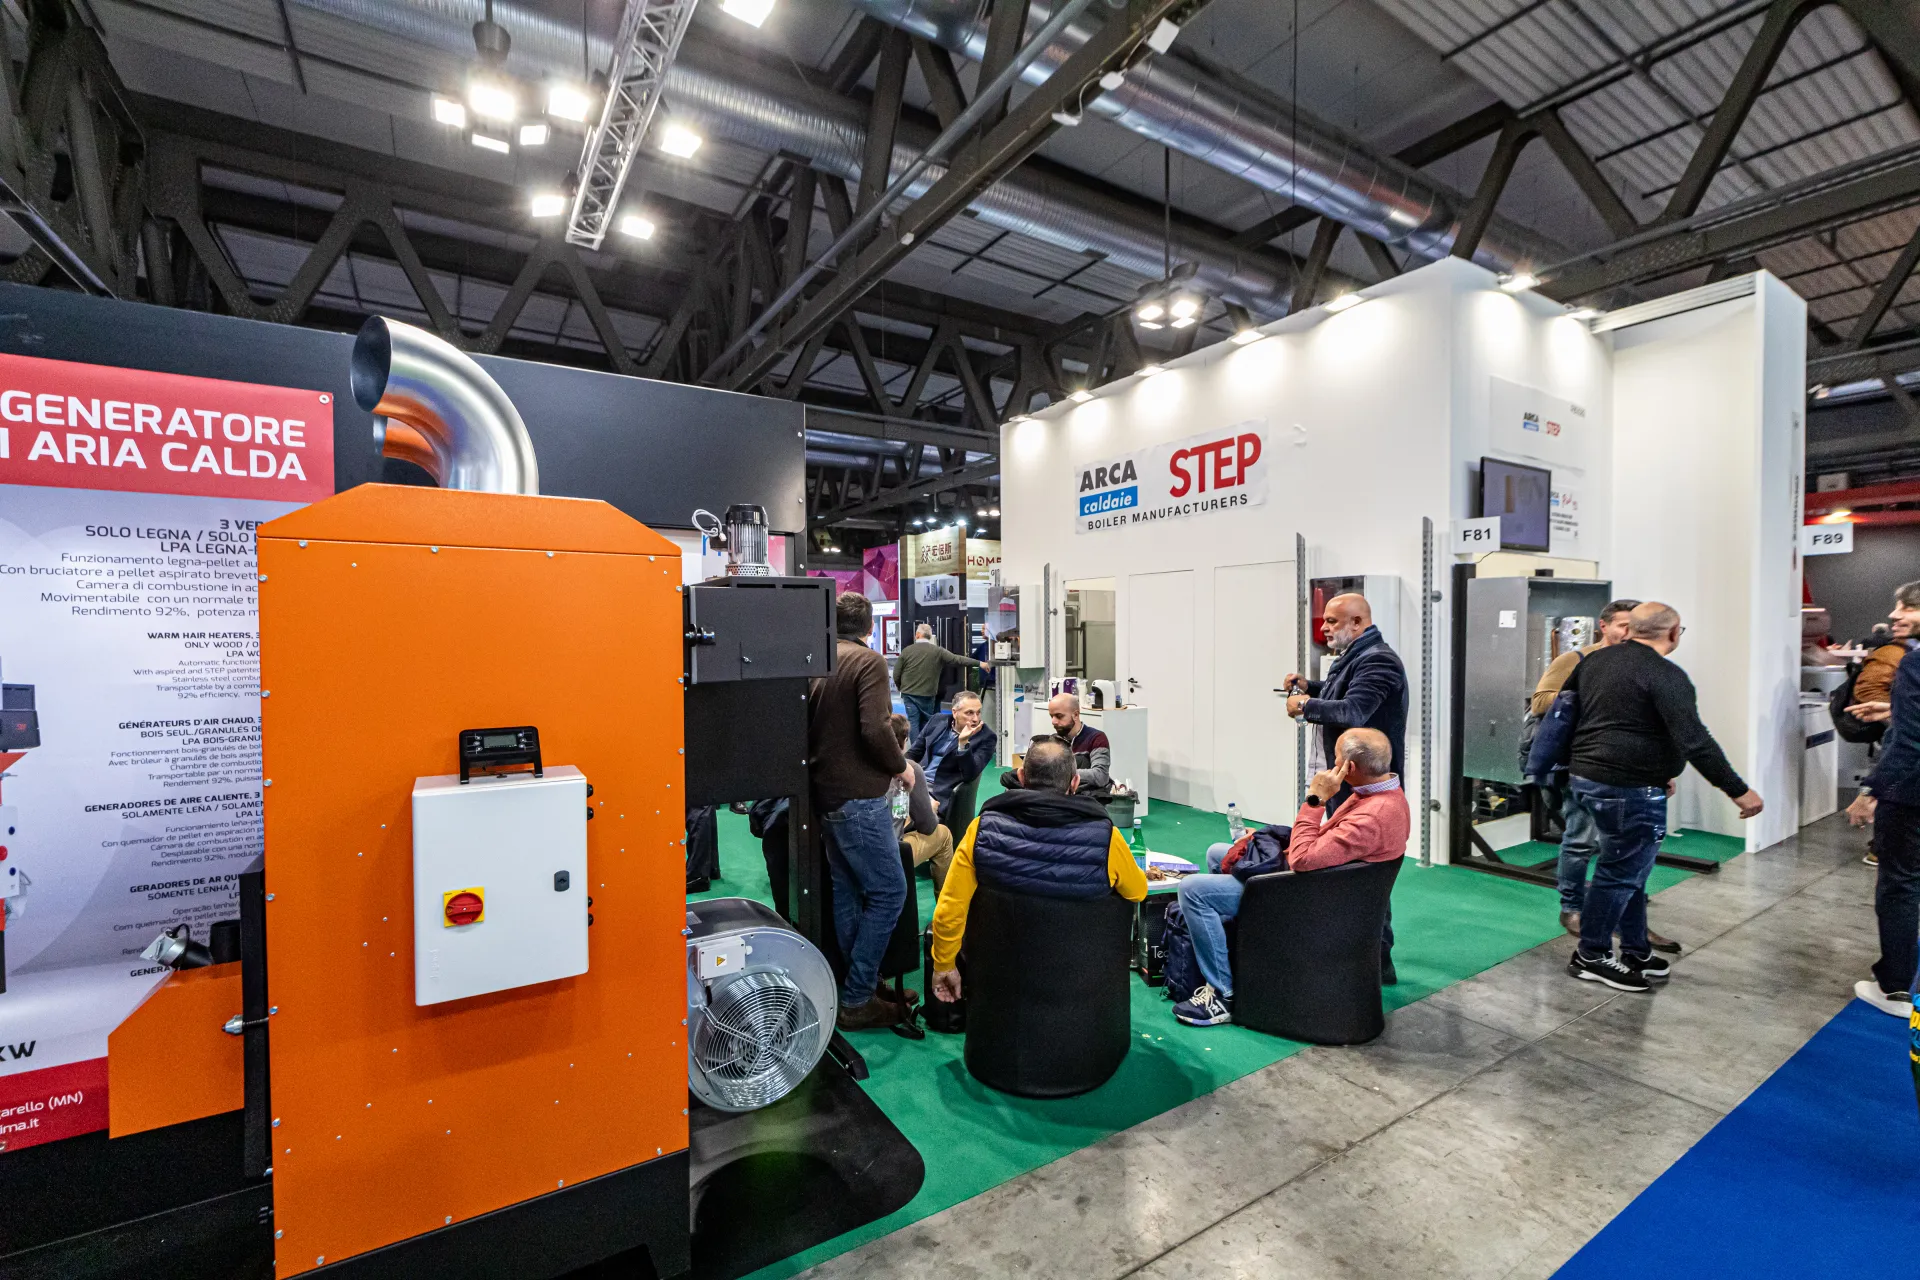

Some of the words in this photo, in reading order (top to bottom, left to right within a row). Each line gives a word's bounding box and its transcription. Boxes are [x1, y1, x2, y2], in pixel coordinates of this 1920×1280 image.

[0, 390, 306, 448] GENERATORE
[28, 431, 147, 469] ARIA
[161, 442, 306, 480] CALDA
[1170, 433, 1261, 497] STEP
[1080, 460, 1137, 492] ARCA
[1084, 492, 1132, 514] caldaie
[1088, 515, 1127, 530] BOILER
[1132, 494, 1248, 522] MANUFACTURERS
[220, 519, 229, 529] 3
[86, 525, 131, 538] SOLO
[136, 528, 191, 540] LEGNA
[197, 530, 203, 541] /
[208, 531, 249, 543] SOLO
[1463, 528, 1491, 542] F81
[1812, 533, 1843, 546] F89
[160, 542, 191, 553] LPA
[62, 553, 163, 565] Funzionamento
[168, 556, 240, 568] legna-pellet
[0, 564, 25, 574] Con
[30, 565, 102, 576] bruciatore
[119, 568, 154, 579] pellet
[159, 569, 210, 580] aspirato
[77, 580, 128, 590] Camera
[133, 581, 144, 590] di
[148, 582, 228, 591] combustione
[232, 583, 242, 592] in
[41, 592, 139, 602] Movimentabile
[193, 595, 243, 604] normale
[72, 606, 151, 616] Rendimento
[156, 607, 190, 616] 92%,
[198, 608, 245, 618] potenza
[156, 684, 212, 692] Transportable
[119, 719, 191, 730] GÉNÉRATEURS
[194, 718, 219, 726] D'AIR
[111, 749, 179, 758] Fonctionnement
[172, 754, 208, 764] granulés
[170, 762, 207, 771] Chambre
[148, 771, 206, 781] Transportable
[164, 779, 209, 787] Rendement
[84, 801, 161, 812] GENERADORES
[164, 798, 176, 806] DE
[180, 796, 202, 804] AIRE
[122, 808, 183, 819] SOLAMENTE
[165, 821, 229, 833] Funcionamiento
[120, 836, 163, 847] quemador
[179, 832, 201, 841] pellet
[161, 848, 210, 859] Desplazable
[151, 857, 202, 867] Rendimiento
[130, 879, 190, 893] GERADORES
[193, 877, 206, 885] DE
[208, 875, 221, 883] AR
[198, 884, 229, 894] LENHA
[0, 1101, 44, 1119] arello
[48, 1090, 83, 1110] (MN)
